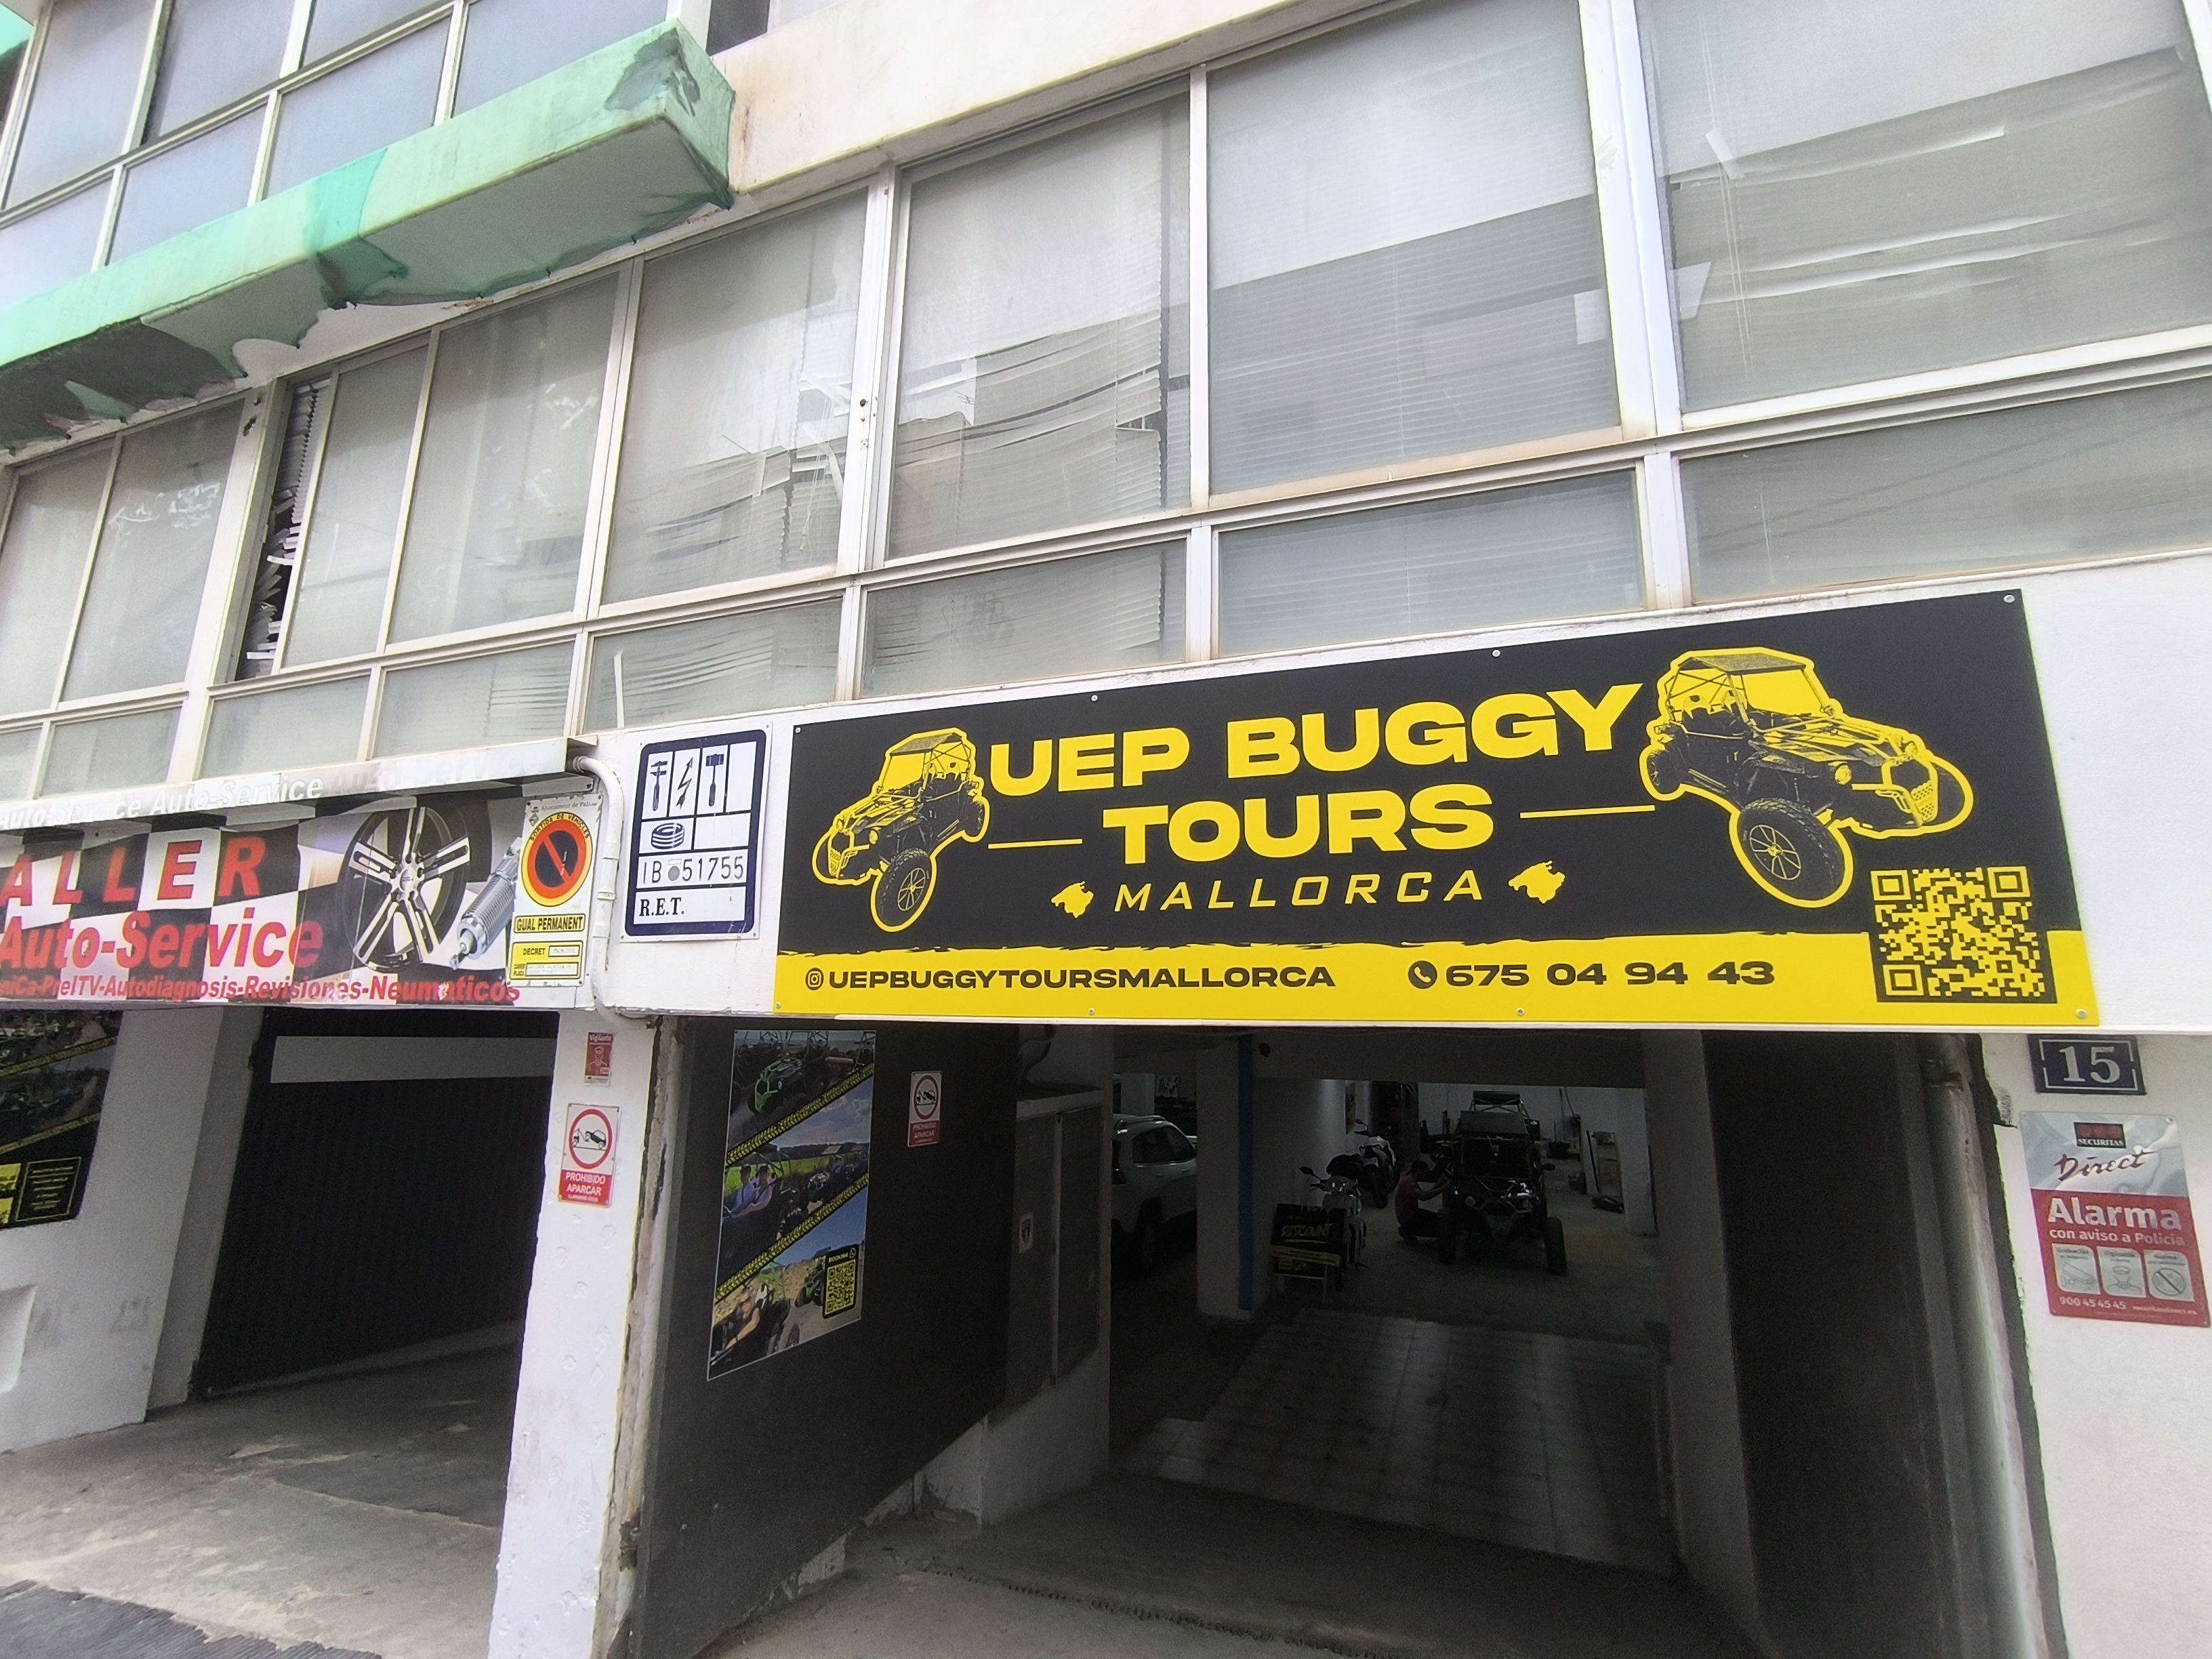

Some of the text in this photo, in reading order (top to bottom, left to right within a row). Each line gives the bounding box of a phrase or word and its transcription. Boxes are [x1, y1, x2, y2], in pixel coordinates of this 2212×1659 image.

[990, 683, 1643, 796] UEP BUGGY
[150, 777, 324, 815] Auto-Service
[530, 818, 554, 841] SORTIDA
[1103, 784, 1494, 865] TOURS
[642, 856, 744, 884] IB 51755
[1115, 870, 1483, 912] MALLORCA
[639, 897, 684, 916] R.E.T.
[517, 916, 583, 931] GUAL PERMANENT
[0, 907, 324, 969] Auto-Service
[523, 947, 546, 956] DECRET
[828, 966, 1336, 989] UEPBUGGYTOURSMALLORCA
[1446, 960, 1776, 987] 675 04 94 43
[2059, 1046, 2121, 1083] 15
[2077, 1138, 2124, 1147] SECURITAS
[565, 1171, 606, 1185] PROHIBIDO
[2053, 1149, 2158, 1182] Direct
[567, 1183, 602, 1196] APARCAR
[2047, 1197, 2182, 1231] Alarma
[2049, 1228, 2186, 1246] con aviso a Policía
[2060, 1296, 2081, 1306] 900
[2083, 1298, 2095, 1308] 45
[2097, 1300, 2112, 1309] 45
[2112, 1301, 2127, 1310] 45
